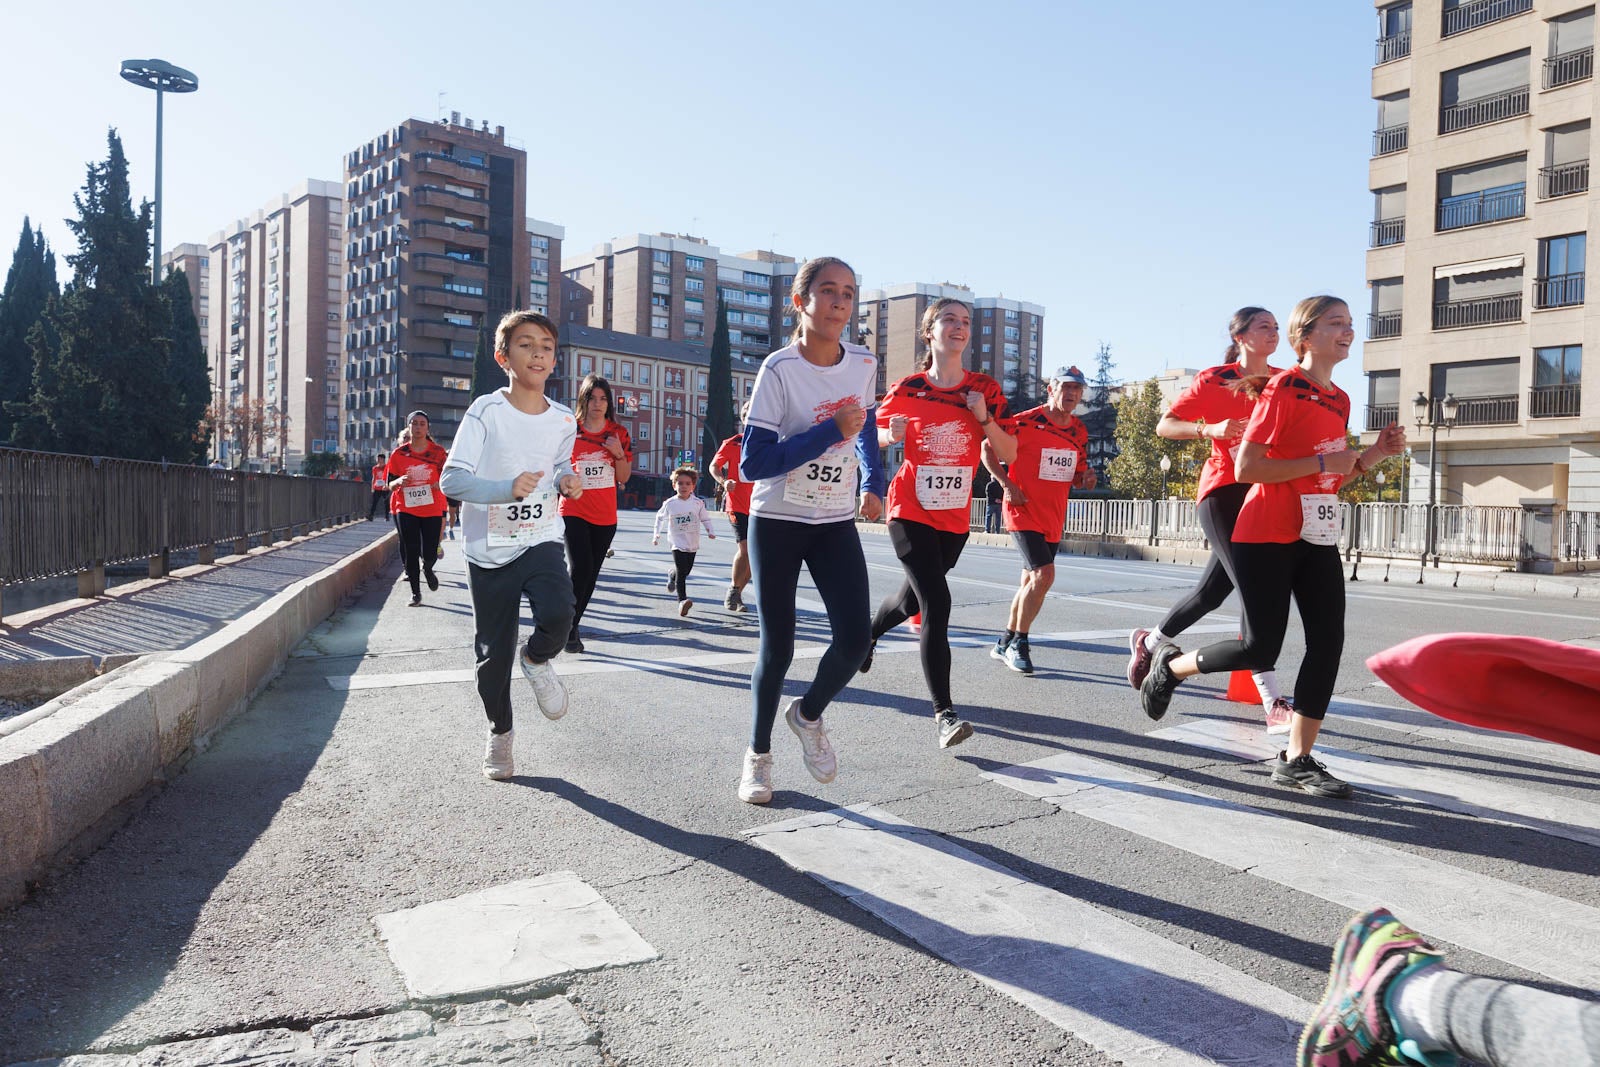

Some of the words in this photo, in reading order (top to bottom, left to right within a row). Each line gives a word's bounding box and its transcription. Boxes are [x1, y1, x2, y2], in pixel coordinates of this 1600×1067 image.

[923, 434, 968, 444] carrera
[685, 450, 692, 459] P
[1047, 456, 1073, 467] 1480
[585, 466, 604, 476] 857
[806, 463, 842, 483] 352
[925, 476, 962, 489] 1378
[408, 489, 427, 498] 1020
[507, 503, 543, 521] 353
[675, 515, 691, 524] 724
